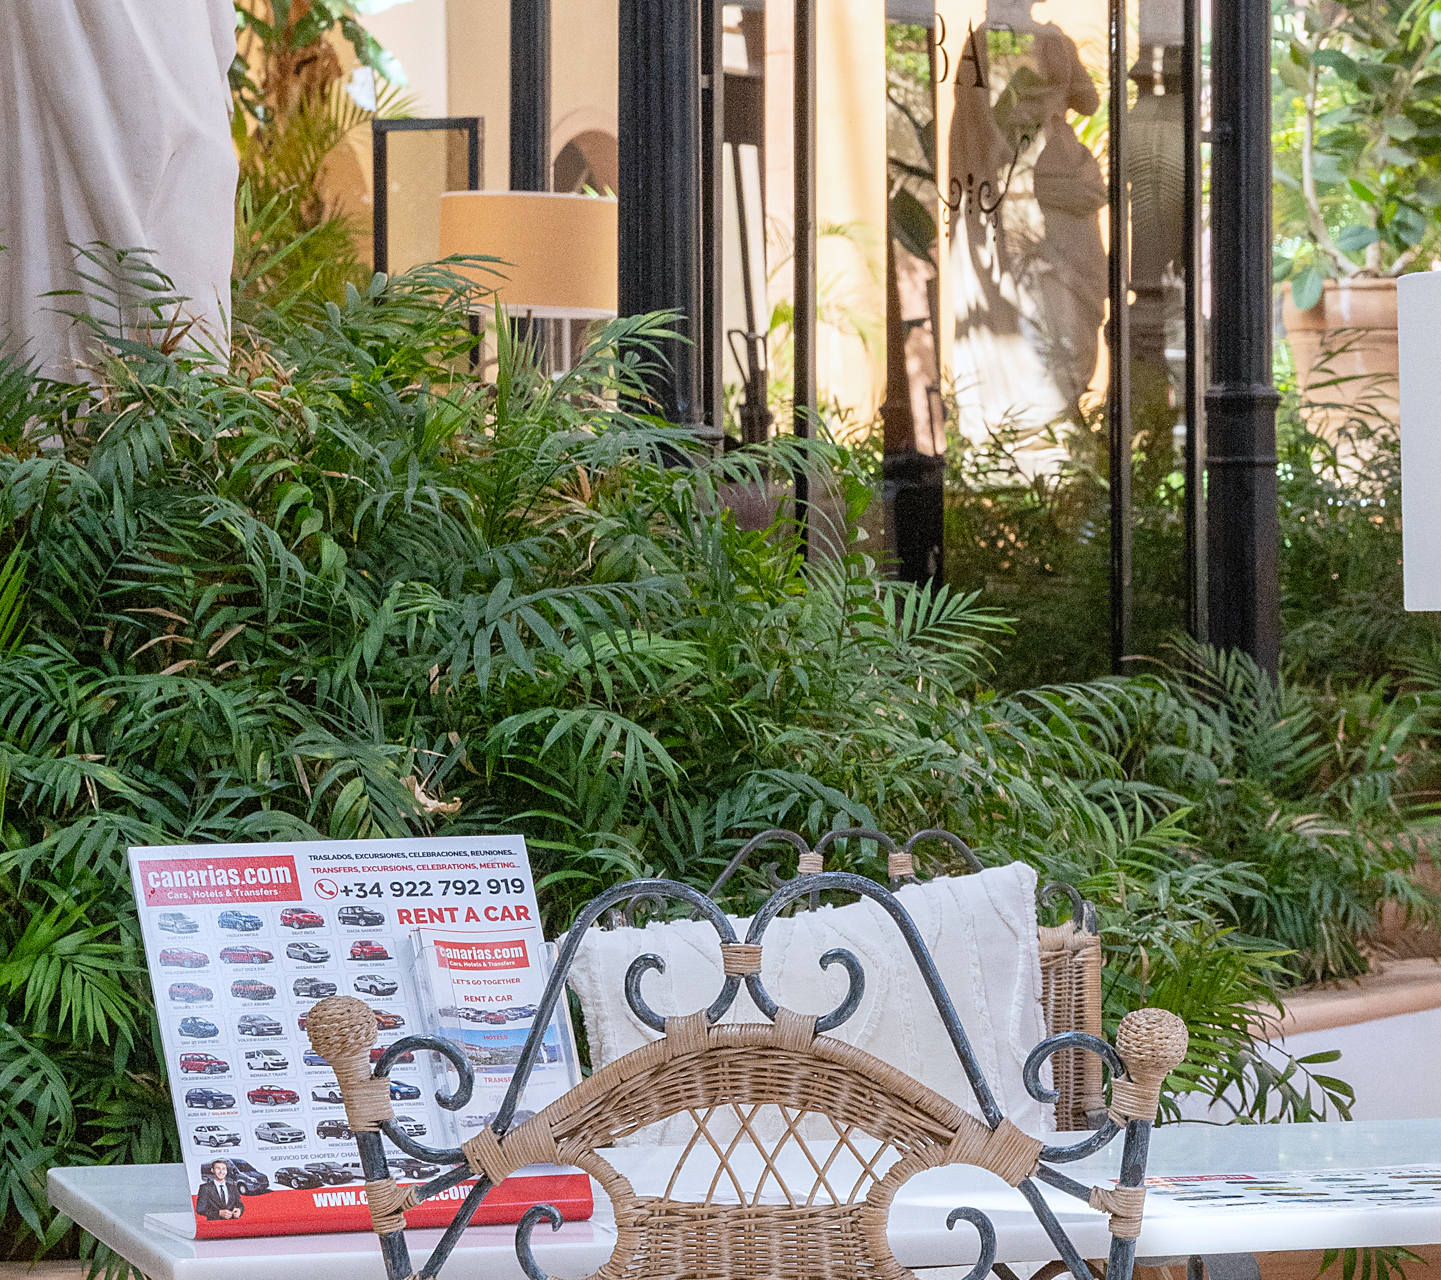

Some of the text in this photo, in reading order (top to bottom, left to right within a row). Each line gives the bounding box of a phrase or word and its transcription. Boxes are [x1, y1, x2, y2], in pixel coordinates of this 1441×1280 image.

[308, 853, 354, 861] TRASLADOS,
[355, 852, 408, 860] EXCURSIONES,
[408, 850, 469, 858] CELEBRACIONES,
[311, 865, 361, 874] TRANSFERS,
[361, 864, 416, 873] EXCURSIONS,
[416, 863, 479, 871] CELEBRATIONS,
[148, 865, 292, 889] canarias.com
[167, 888, 279, 900] Cars, Hotels & Transfers
[340, 878, 525, 899] +34 922 792 919
[397, 905, 532, 925] RENT A CAR
[440, 946, 524, 960] canarias.com
[482, 977, 521, 985] TOGETHER
[495, 994, 513, 1002] CAR
[484, 1076, 513, 1084] TRANSF
[312, 1184, 474, 1208] www.c.com
